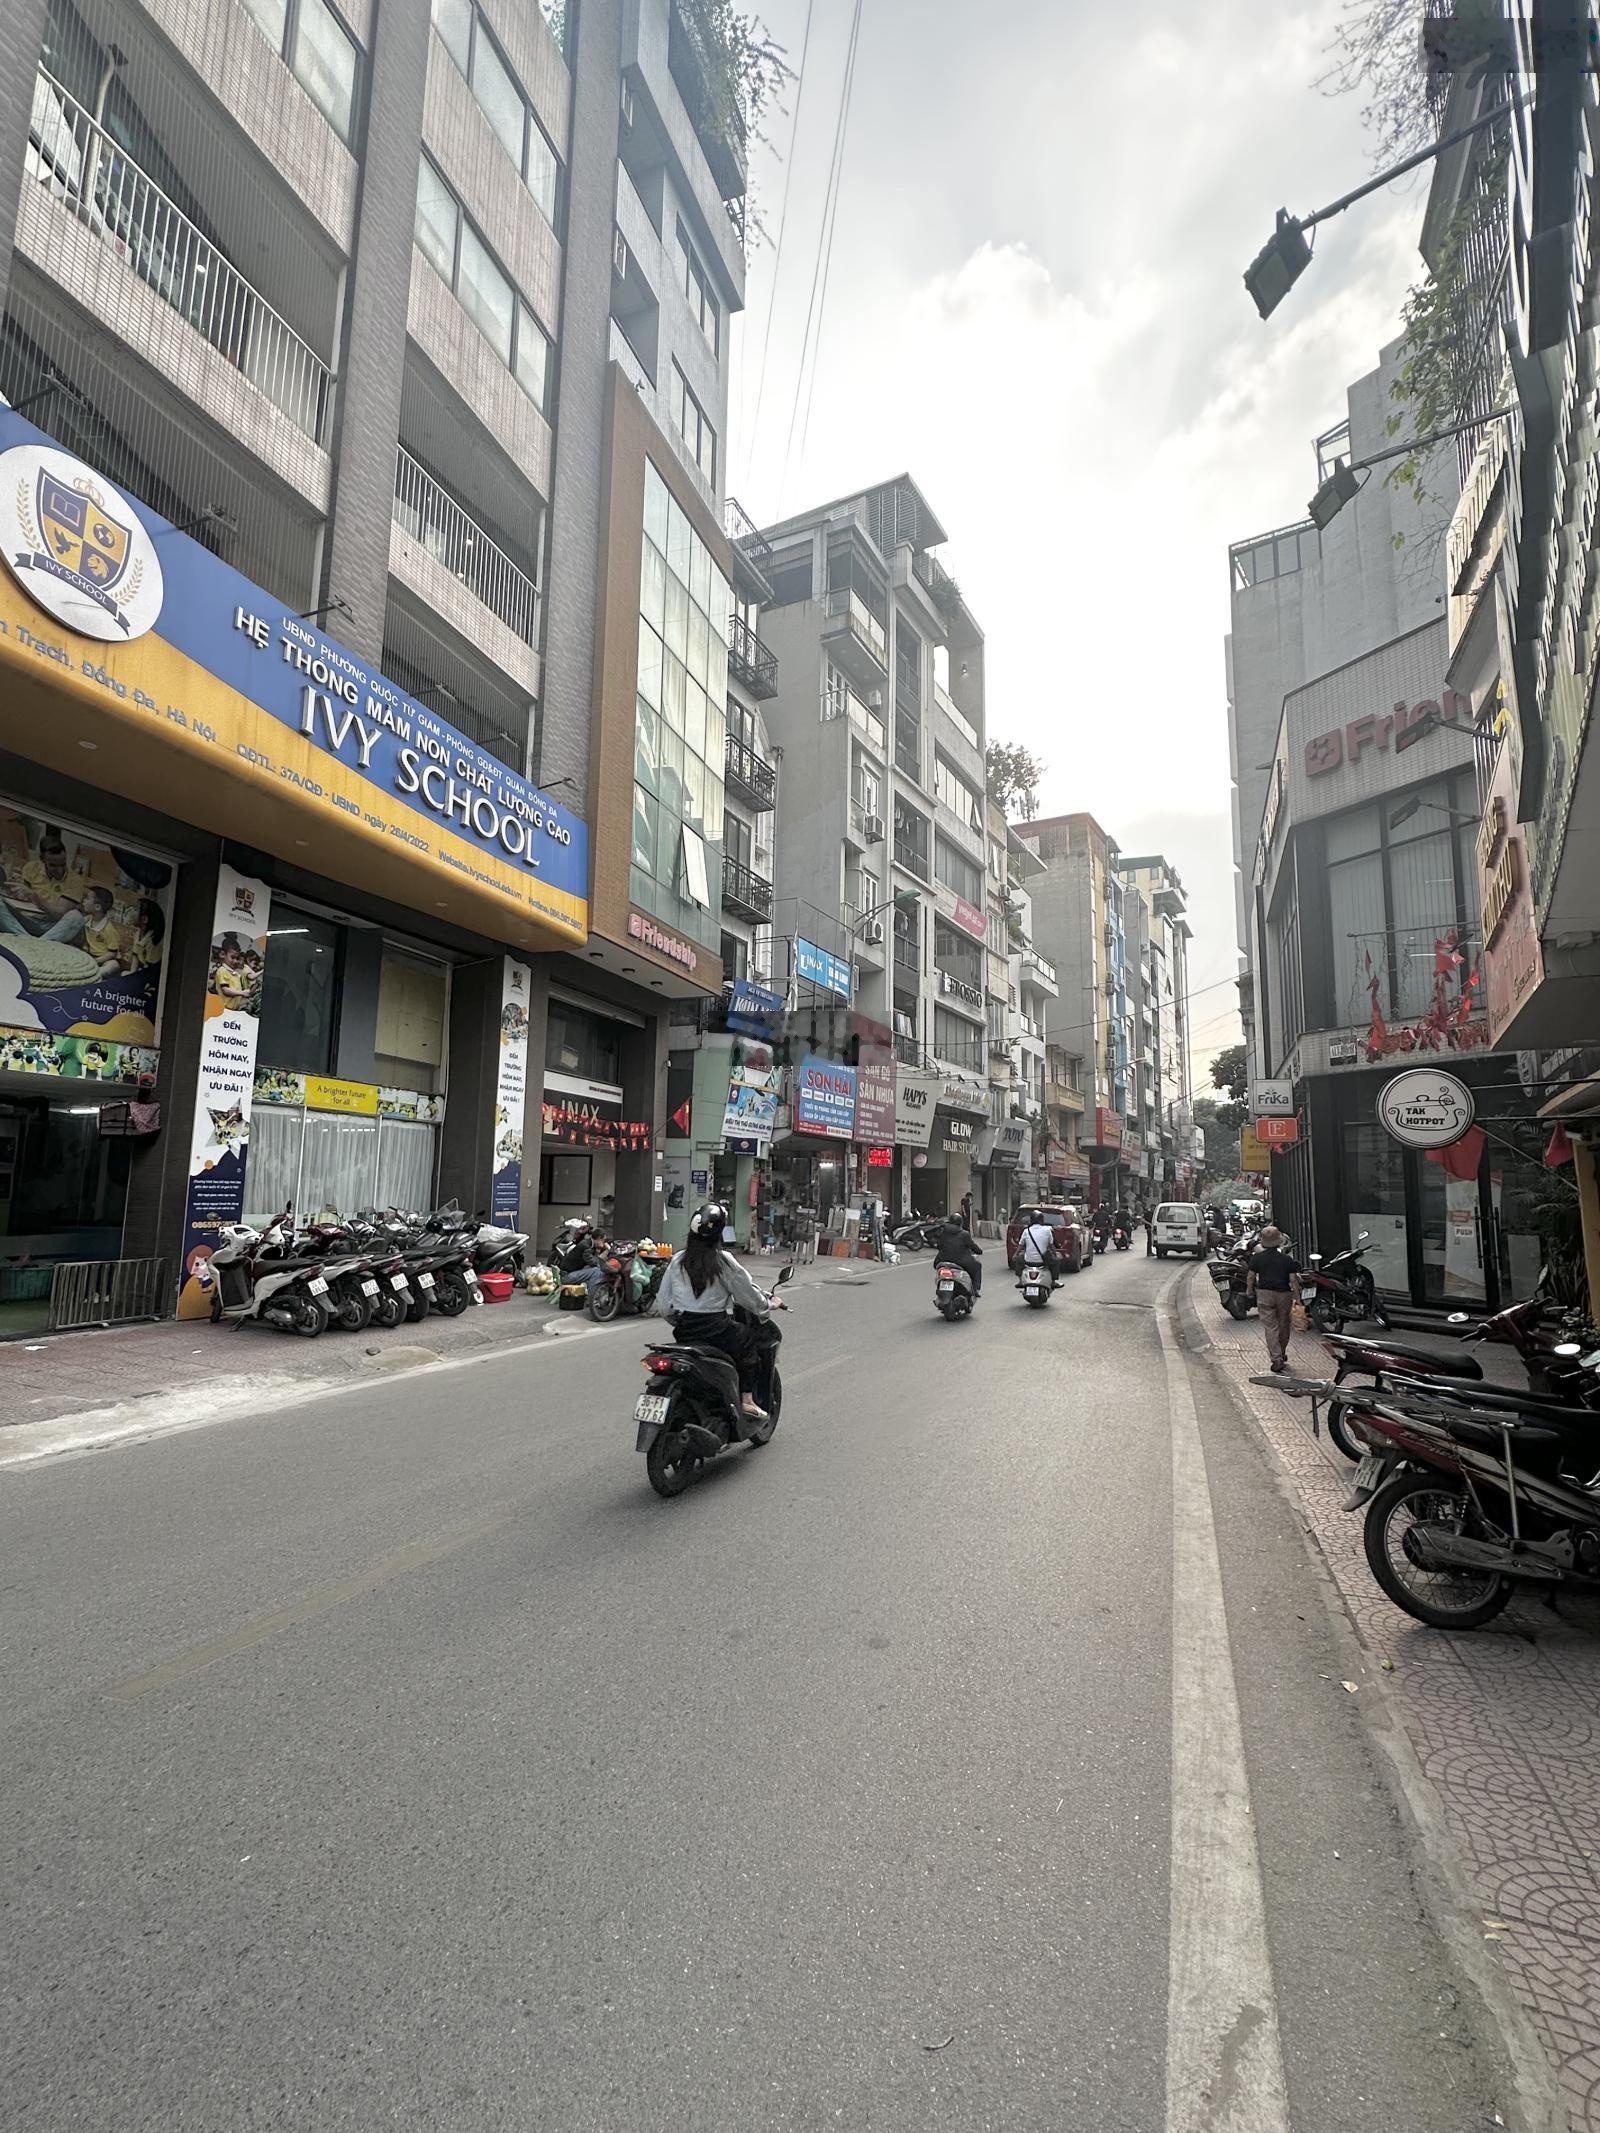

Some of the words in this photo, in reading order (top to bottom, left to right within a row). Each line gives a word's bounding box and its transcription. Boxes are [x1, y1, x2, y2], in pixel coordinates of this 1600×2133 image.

[44, 559, 63, 575] IVY
[65, 569, 108, 605] SCHOOL
[282, 616, 316, 648] UBND
[17, 623, 74, 672] Trạch,
[133, 686, 160, 716] Đa,
[167, 704, 187, 728] Hà
[234, 605, 270, 649] HỆ
[415, 729, 451, 769] NON
[498, 785, 543, 830] LƯỢNG
[546, 818, 572, 847] CAO
[299, 684, 383, 769] IVY
[394, 746, 542, 869] SCHOOL
[331, 792, 361, 817] UBND
[641, 918, 697, 971] Friendship
[81, 998, 114, 1013] future
[93, 988, 102, 998] A
[105, 991, 147, 1007] brighter
[223, 1020, 242, 1031] ĐẾN
[213, 1034, 248, 1048] TRƯỜNG
[208, 1048, 229, 1061] HÔM
[230, 1053, 250, 1064] NAY,
[202, 1065, 228, 1077] NHẬN
[229, 1069, 252, 1079] NGAY
[209, 1081, 222, 1091] ƯU
[317, 1084, 323, 1092] A
[323, 1087, 348, 1099] brighter
[349, 1089, 366, 1099] future
[333, 1096, 341, 1105] for
[342, 1098, 350, 1106] all
[1258, 1094, 1290, 1105] FriKa
[561, 1099, 600, 1126] INAX
[951, 1121, 974, 1139] GLOW
[943, 1138, 959, 1153] HAIR
[1456, 1228, 1472, 1236] PUSH
